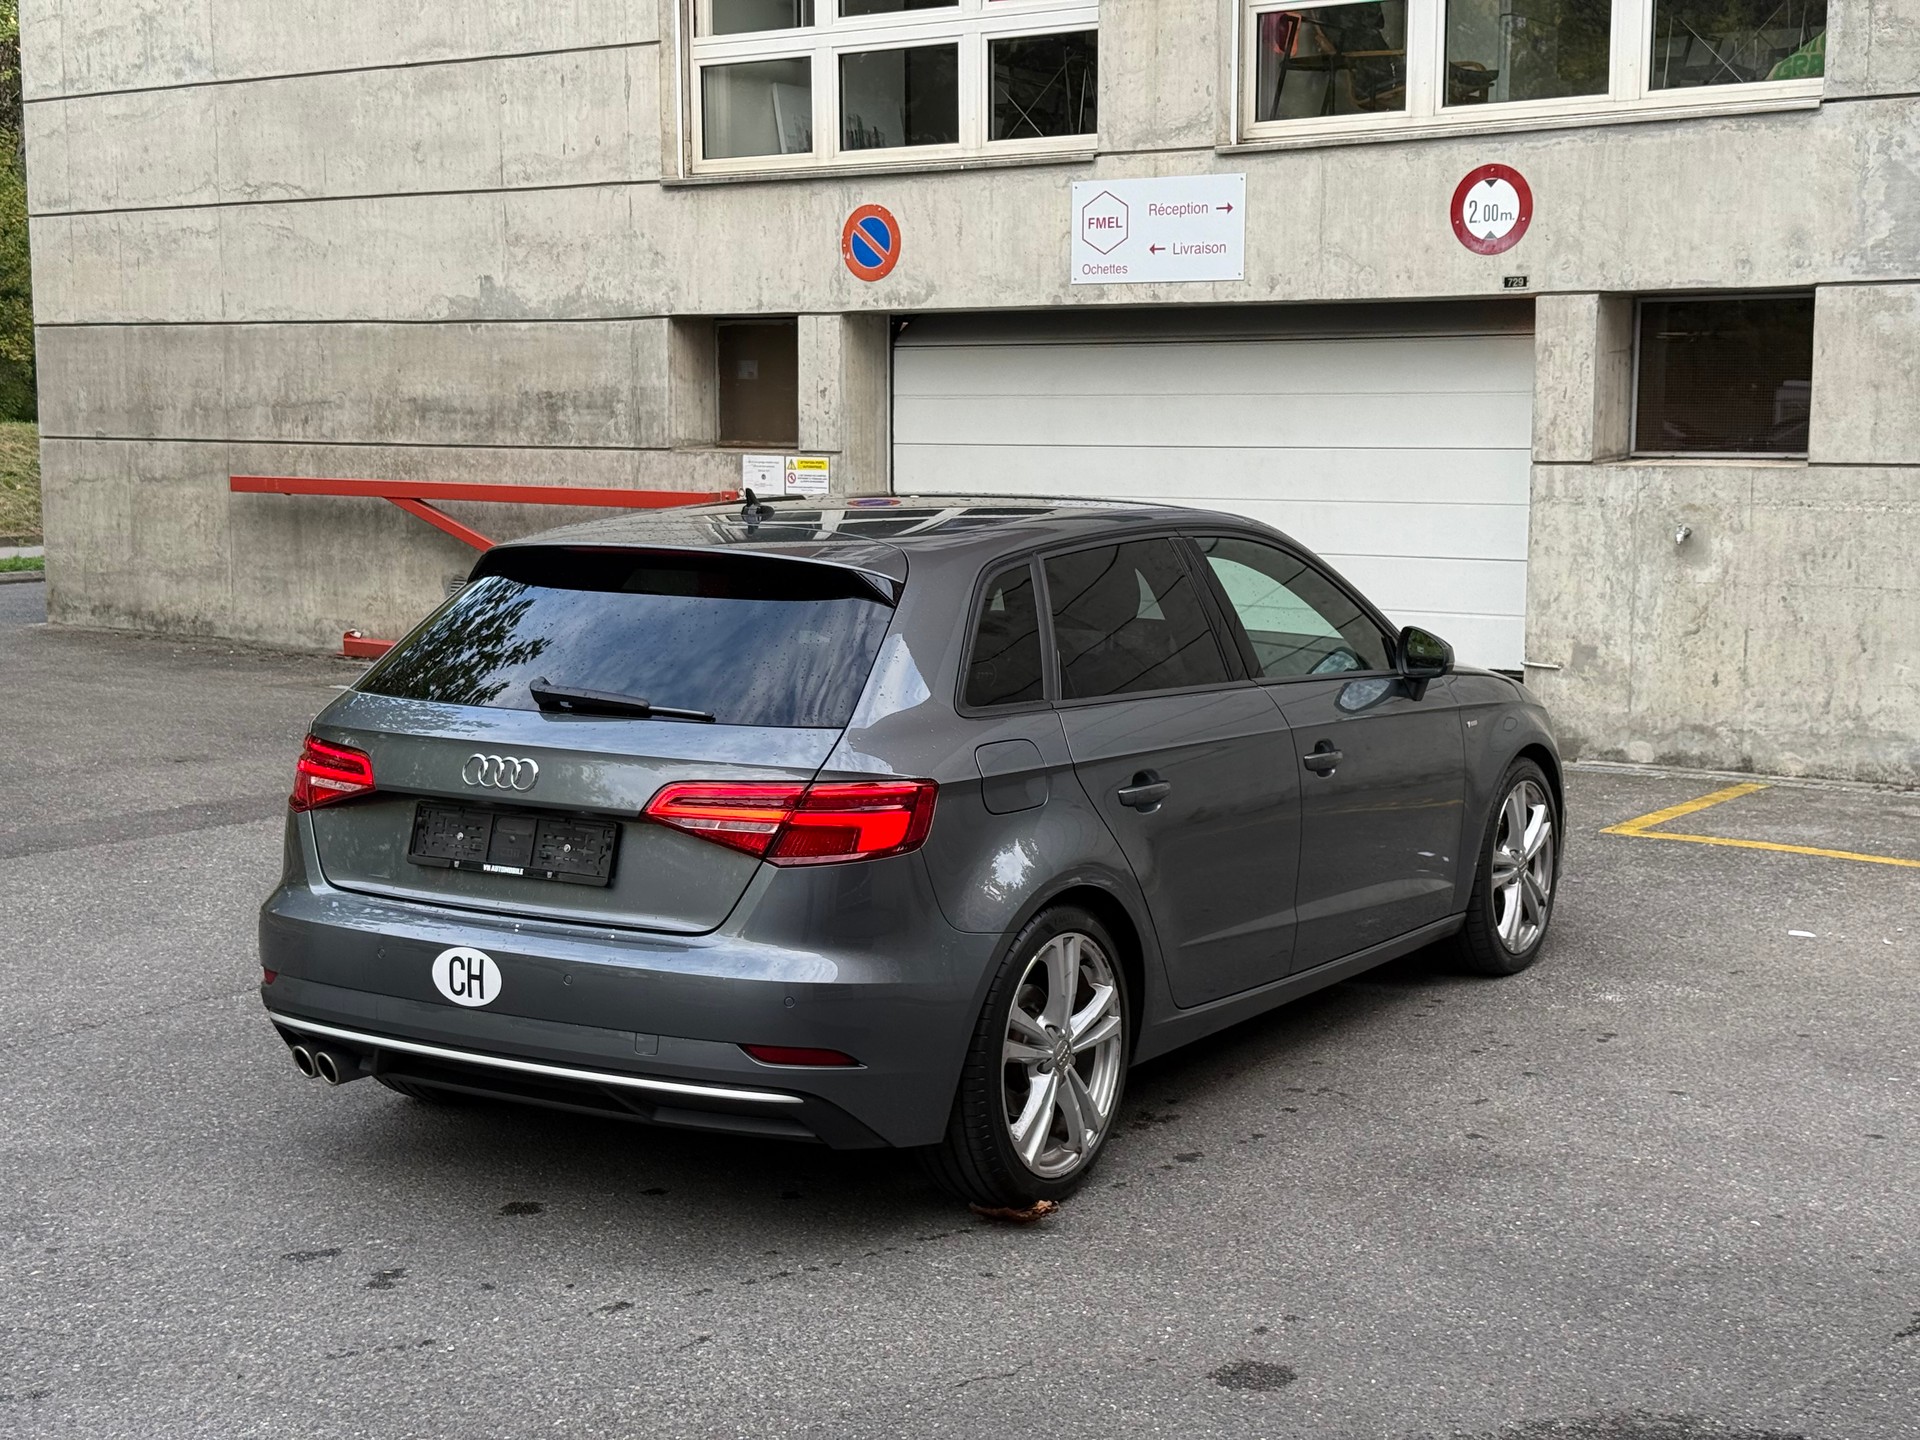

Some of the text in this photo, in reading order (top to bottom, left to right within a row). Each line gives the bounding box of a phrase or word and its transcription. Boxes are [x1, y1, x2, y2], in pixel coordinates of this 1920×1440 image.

[1148, 202, 1208, 218] Réception
[1088, 216, 1123, 229] FMEL
[1172, 242, 1227, 255] Livraison
[1082, 263, 1128, 275] Ochettes
[1507, 277, 1524, 287] 729
[449, 956, 484, 1000] CH
